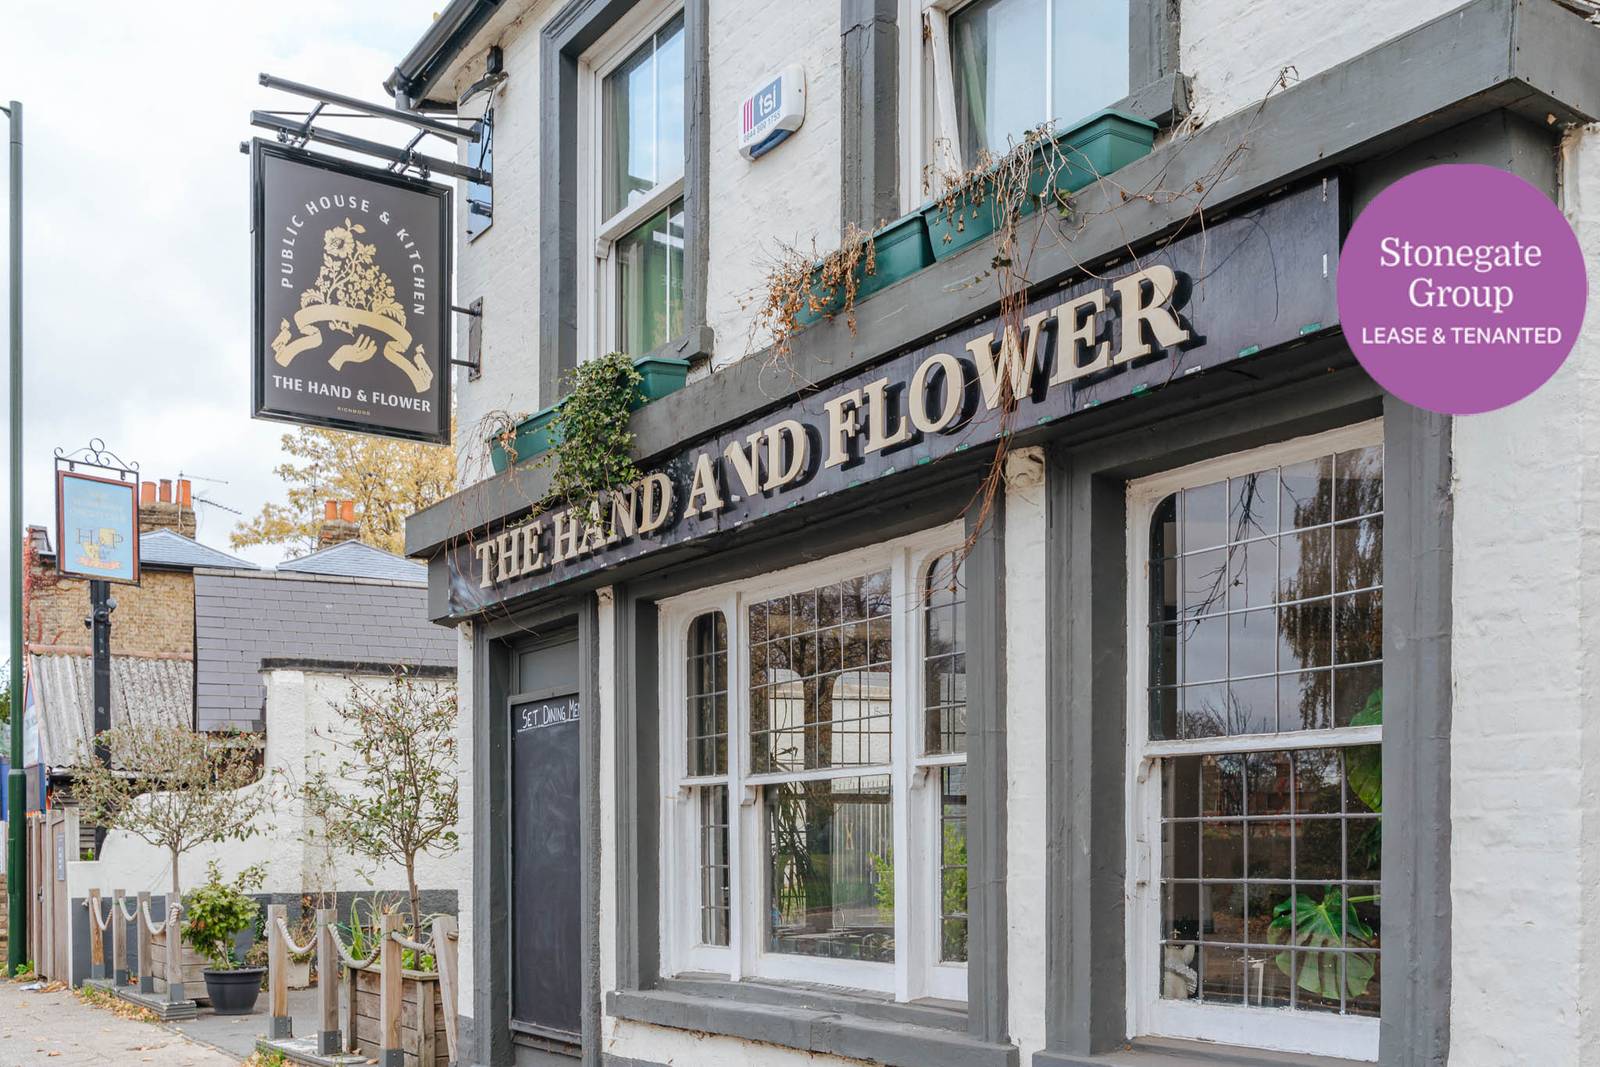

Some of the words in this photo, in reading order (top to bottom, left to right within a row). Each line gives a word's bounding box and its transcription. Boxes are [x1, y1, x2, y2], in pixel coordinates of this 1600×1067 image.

[281, 215, 304, 288] PUBLIC
[305, 195, 370, 215] HOUSE
[379, 211, 390, 225] &
[396, 228, 425, 315] KITCHEN
[273, 375, 303, 392] THE
[308, 381, 351, 399] HAND
[356, 389, 368, 403] &
[372, 392, 431, 413] FLOWER
[476, 520, 543, 589] THE
[551, 472, 675, 565] HAND
[683, 419, 809, 519] AND
[824, 265, 1190, 469] FLOWER
